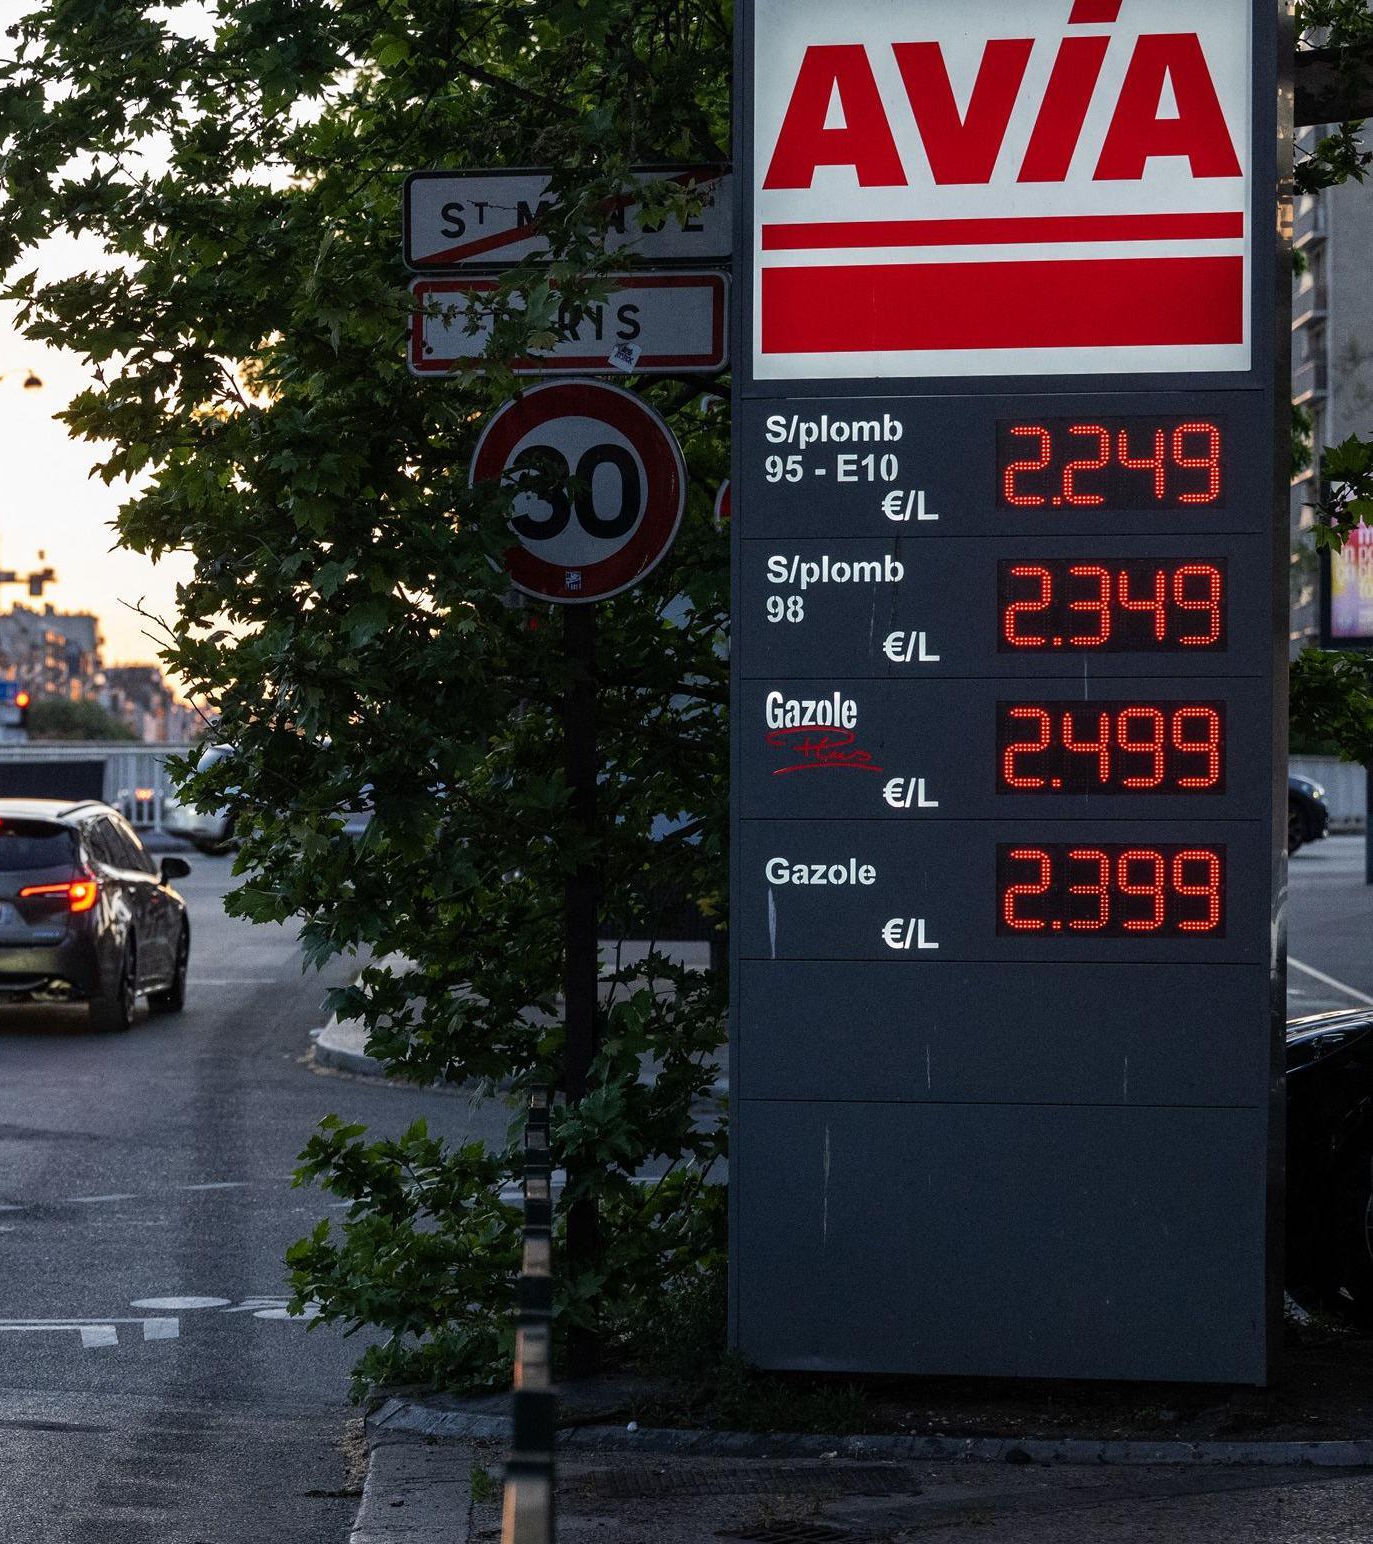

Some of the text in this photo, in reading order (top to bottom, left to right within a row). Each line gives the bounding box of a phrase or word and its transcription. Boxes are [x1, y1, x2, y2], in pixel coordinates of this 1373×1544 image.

[765, 413, 903, 450] S/plomb
[765, 455, 804, 483] 95
[837, 453, 899, 482] E10
[1003, 422, 1221, 506] 2.249
[510, 443, 641, 540] 30
[881, 489, 939, 521] €/L
[766, 554, 905, 590] S/plomb
[766, 595, 805, 623] 98
[1004, 564, 1222, 647] 2.349
[882, 630, 940, 662] €/L
[765, 690, 858, 729] Gazole
[1003, 706, 1220, 788] 2.499
[882, 777, 939, 808] €/L
[765, 857, 877, 885] Gazole
[1003, 849, 1221, 932] 2.399
[881, 917, 939, 949] €/L
